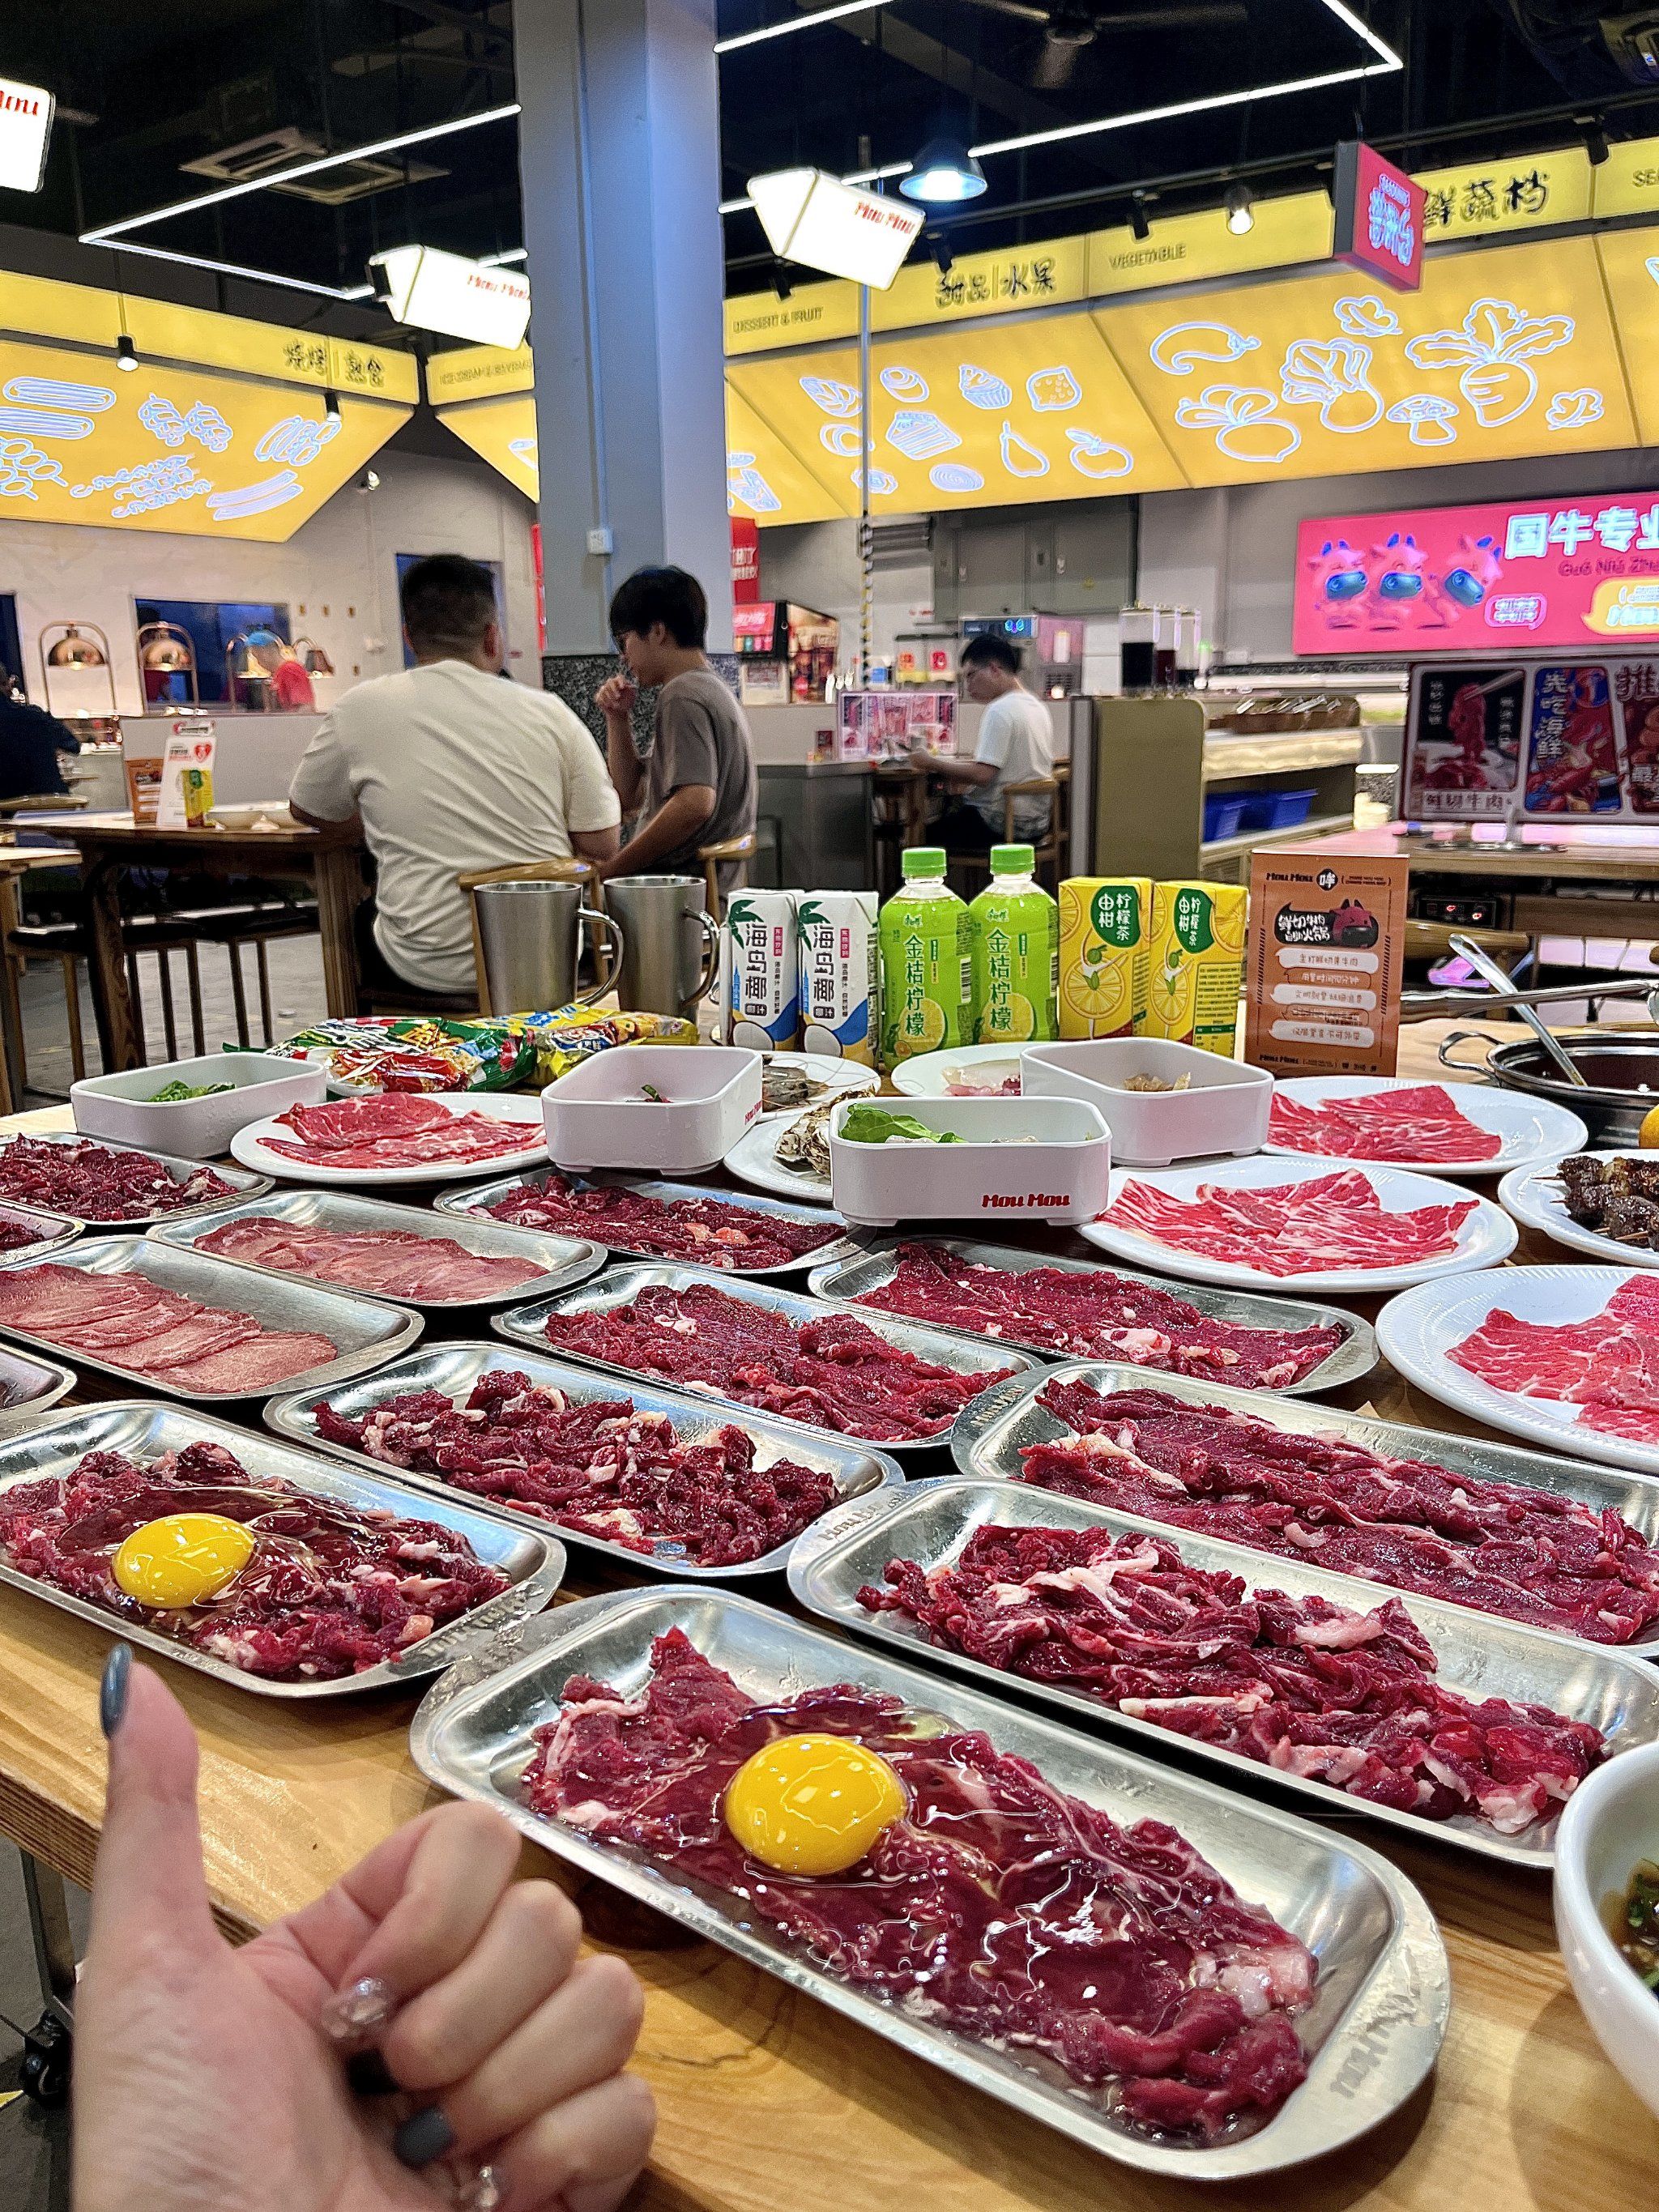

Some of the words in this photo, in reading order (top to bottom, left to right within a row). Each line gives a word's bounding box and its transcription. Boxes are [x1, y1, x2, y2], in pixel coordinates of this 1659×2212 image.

[1000, 259, 1056, 302] 水果
[1116, 893, 1132, 941] 柠檬茶
[1188, 897, 1202, 946] 柠檬茶
[745, 923, 767, 1000] 海岛椰
[813, 925, 834, 1003] 海岛椰
[904, 934, 925, 1037] 金桔柠檬
[987, 929, 1012, 1031] 金桔柠檬
[982, 1195, 1025, 1208] Mou
[1027, 1194, 1070, 1207] Mou
